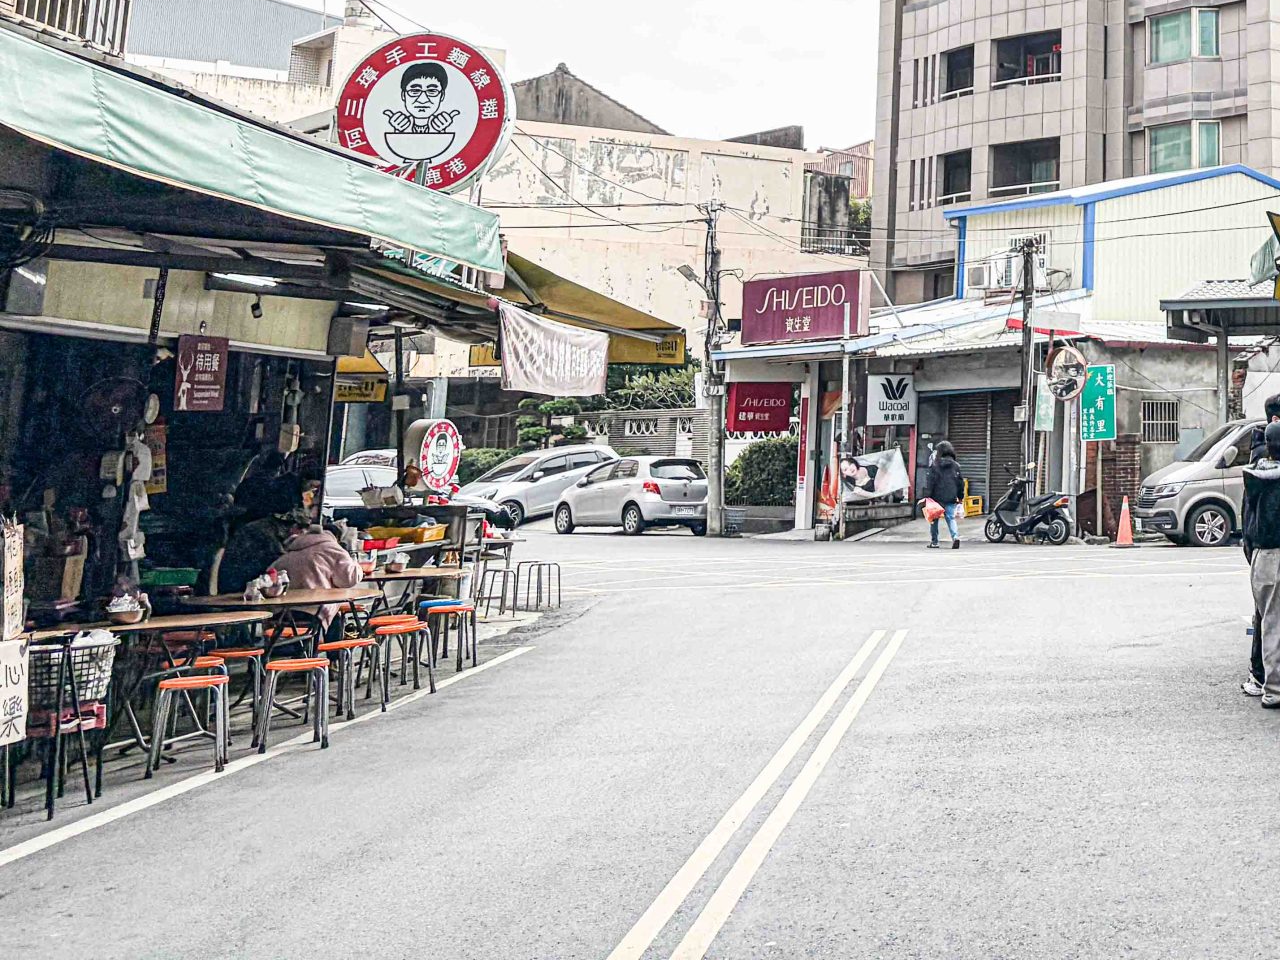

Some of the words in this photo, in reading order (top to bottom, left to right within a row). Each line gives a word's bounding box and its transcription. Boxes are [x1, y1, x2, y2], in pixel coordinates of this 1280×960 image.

[755, 283, 846, 314] SHISEIDO
[785, 315, 812, 333] 資生堂
[196, 353, 220, 371] 待用餐
[740, 397, 786, 407] SHISEIDO
[879, 401, 909, 411] Wacoal
[1095, 373, 1106, 432] 大有里
[0, 661, 24, 688] 心
